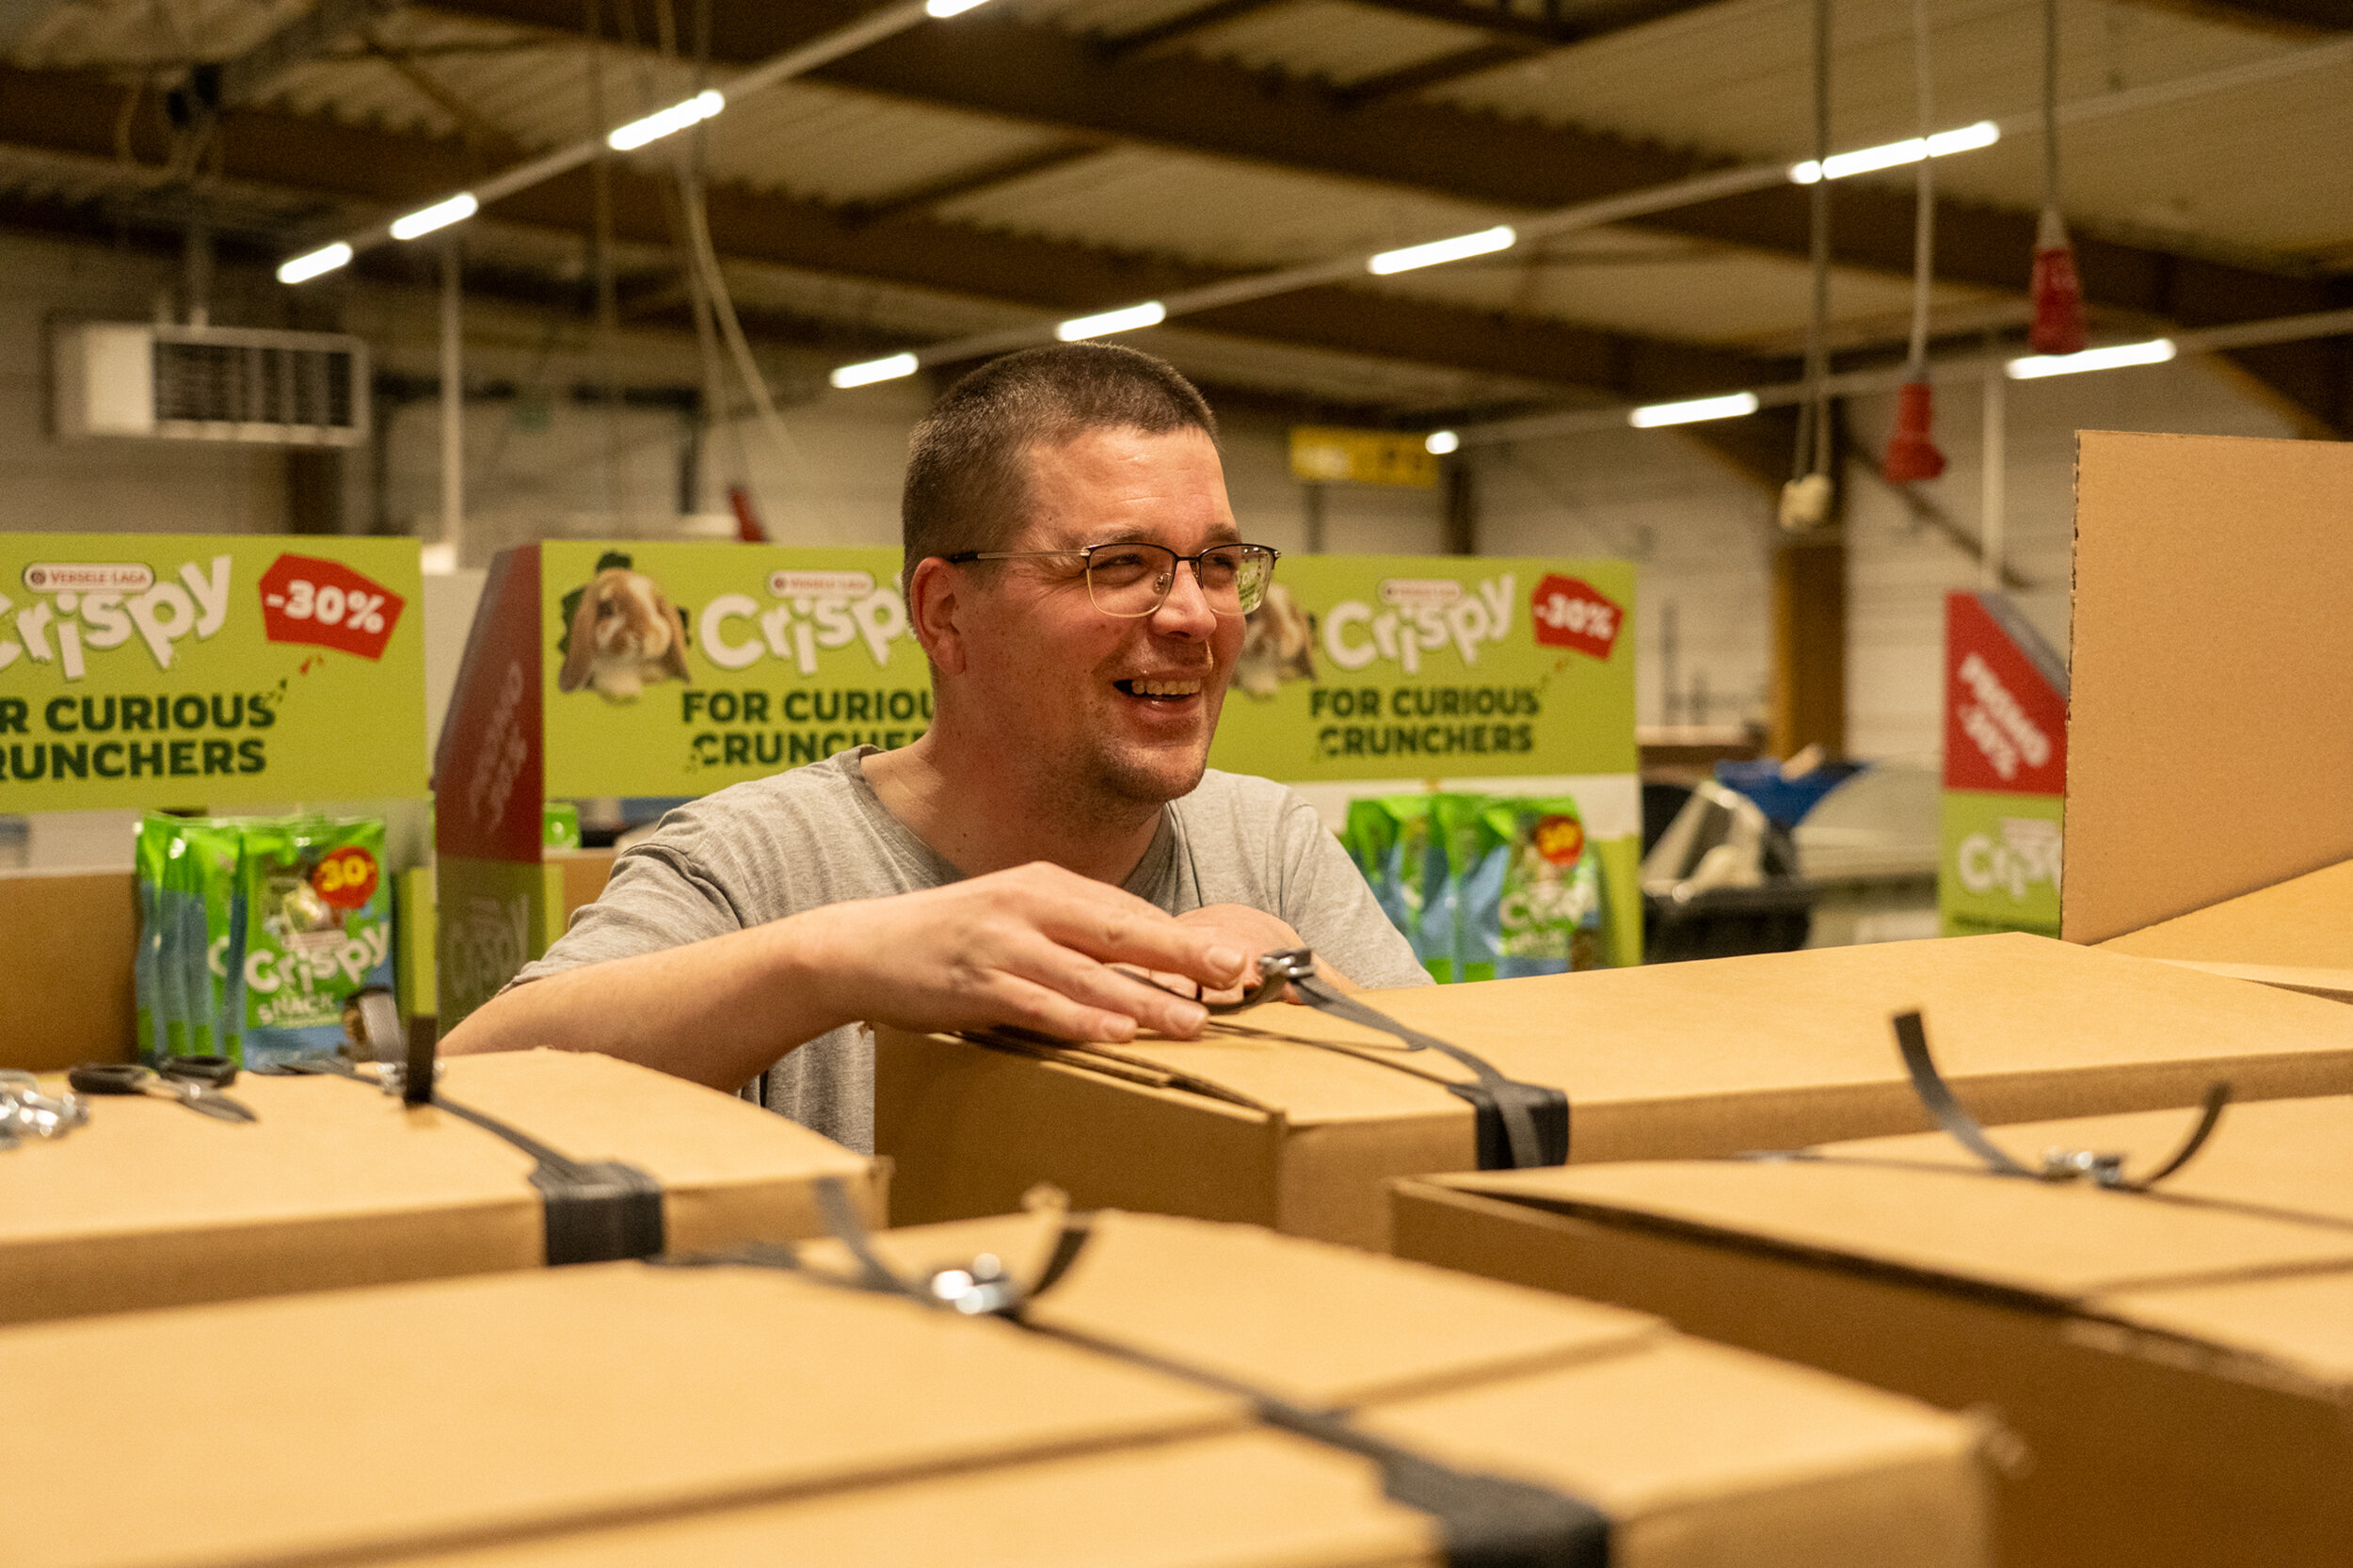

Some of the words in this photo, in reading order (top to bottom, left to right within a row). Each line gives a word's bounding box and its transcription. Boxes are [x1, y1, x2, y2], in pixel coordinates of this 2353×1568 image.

[265, 580, 386, 634] -30%
[699, 574, 918, 675] Crisp
[1323, 573, 1516, 674] Crispy
[1534, 592, 1614, 641] -30%
[45, 693, 277, 734] CURIOUS
[681, 690, 770, 723] FOR
[1311, 688, 1381, 718] FOR
[1392, 685, 1540, 717] CURIOUS
[0, 737, 267, 782] UNCHERS
[1319, 723, 1534, 756] CRUNCHERS
[243, 921, 389, 995] Crispy
